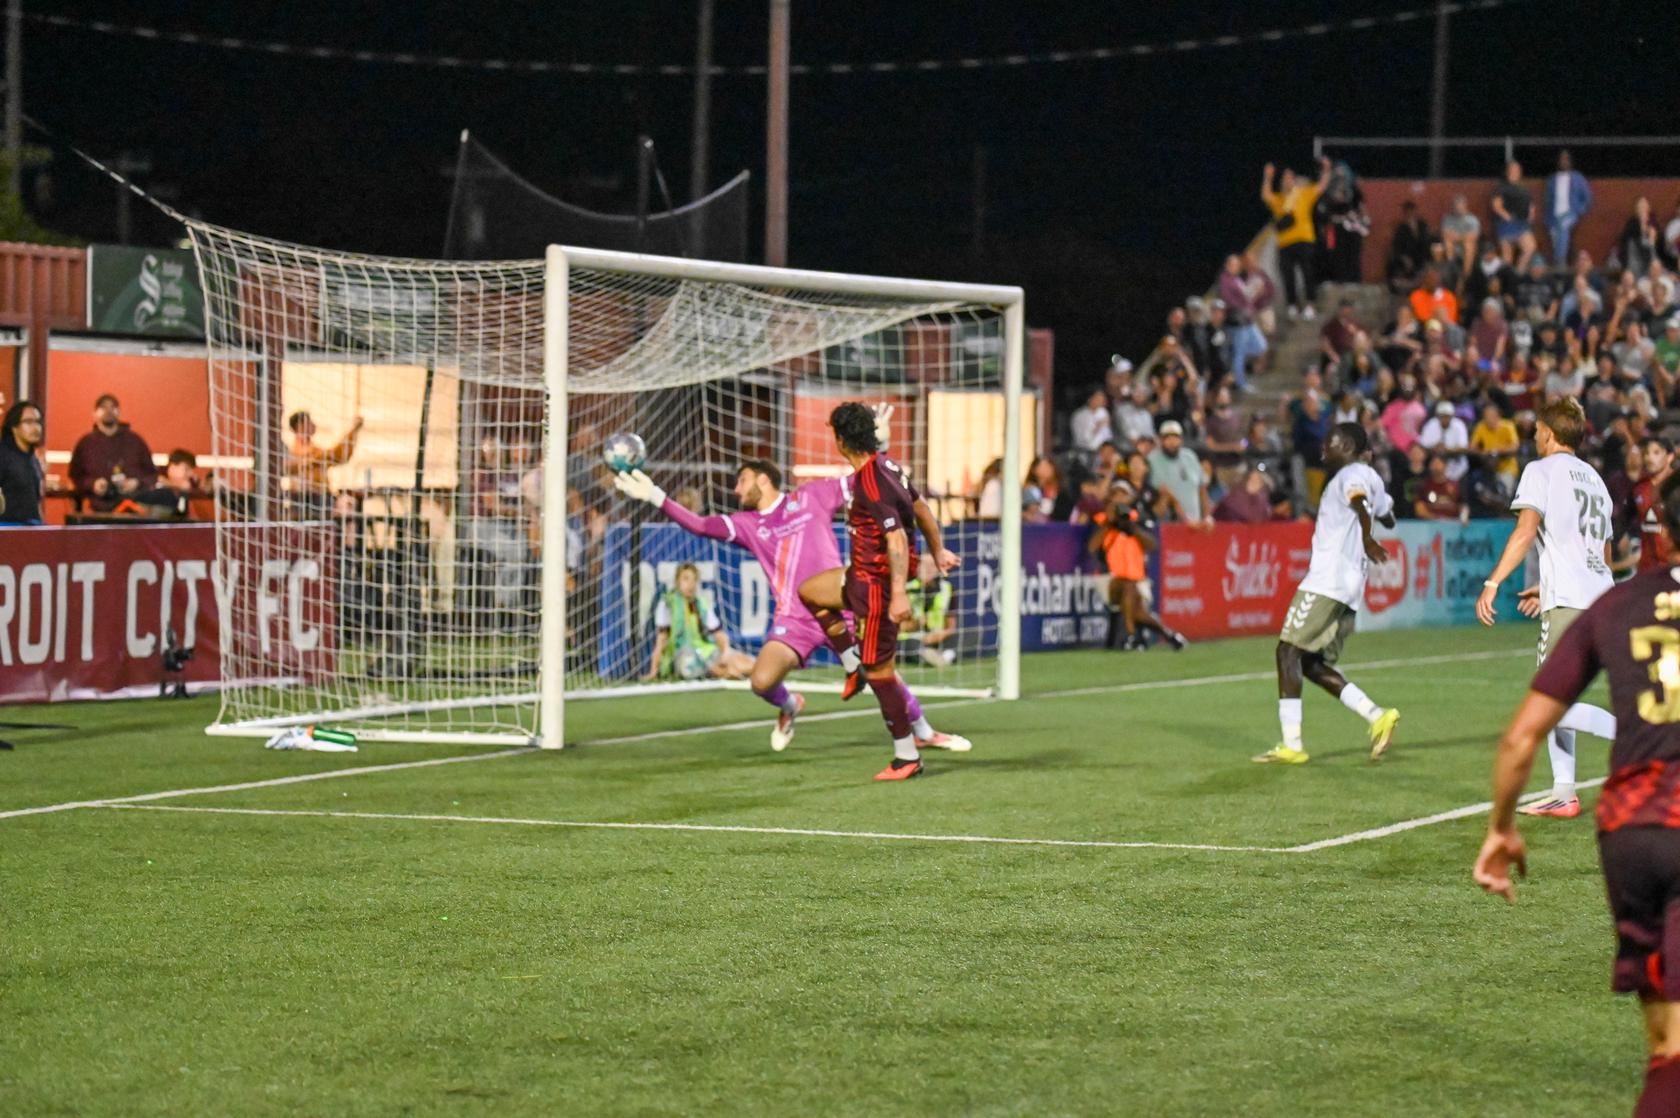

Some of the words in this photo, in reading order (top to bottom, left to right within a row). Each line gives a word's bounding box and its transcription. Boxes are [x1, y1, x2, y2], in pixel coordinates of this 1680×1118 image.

[1573, 488, 1607, 541] 25
[126, 559, 240, 658] CITY
[258, 558, 319, 653] FC
